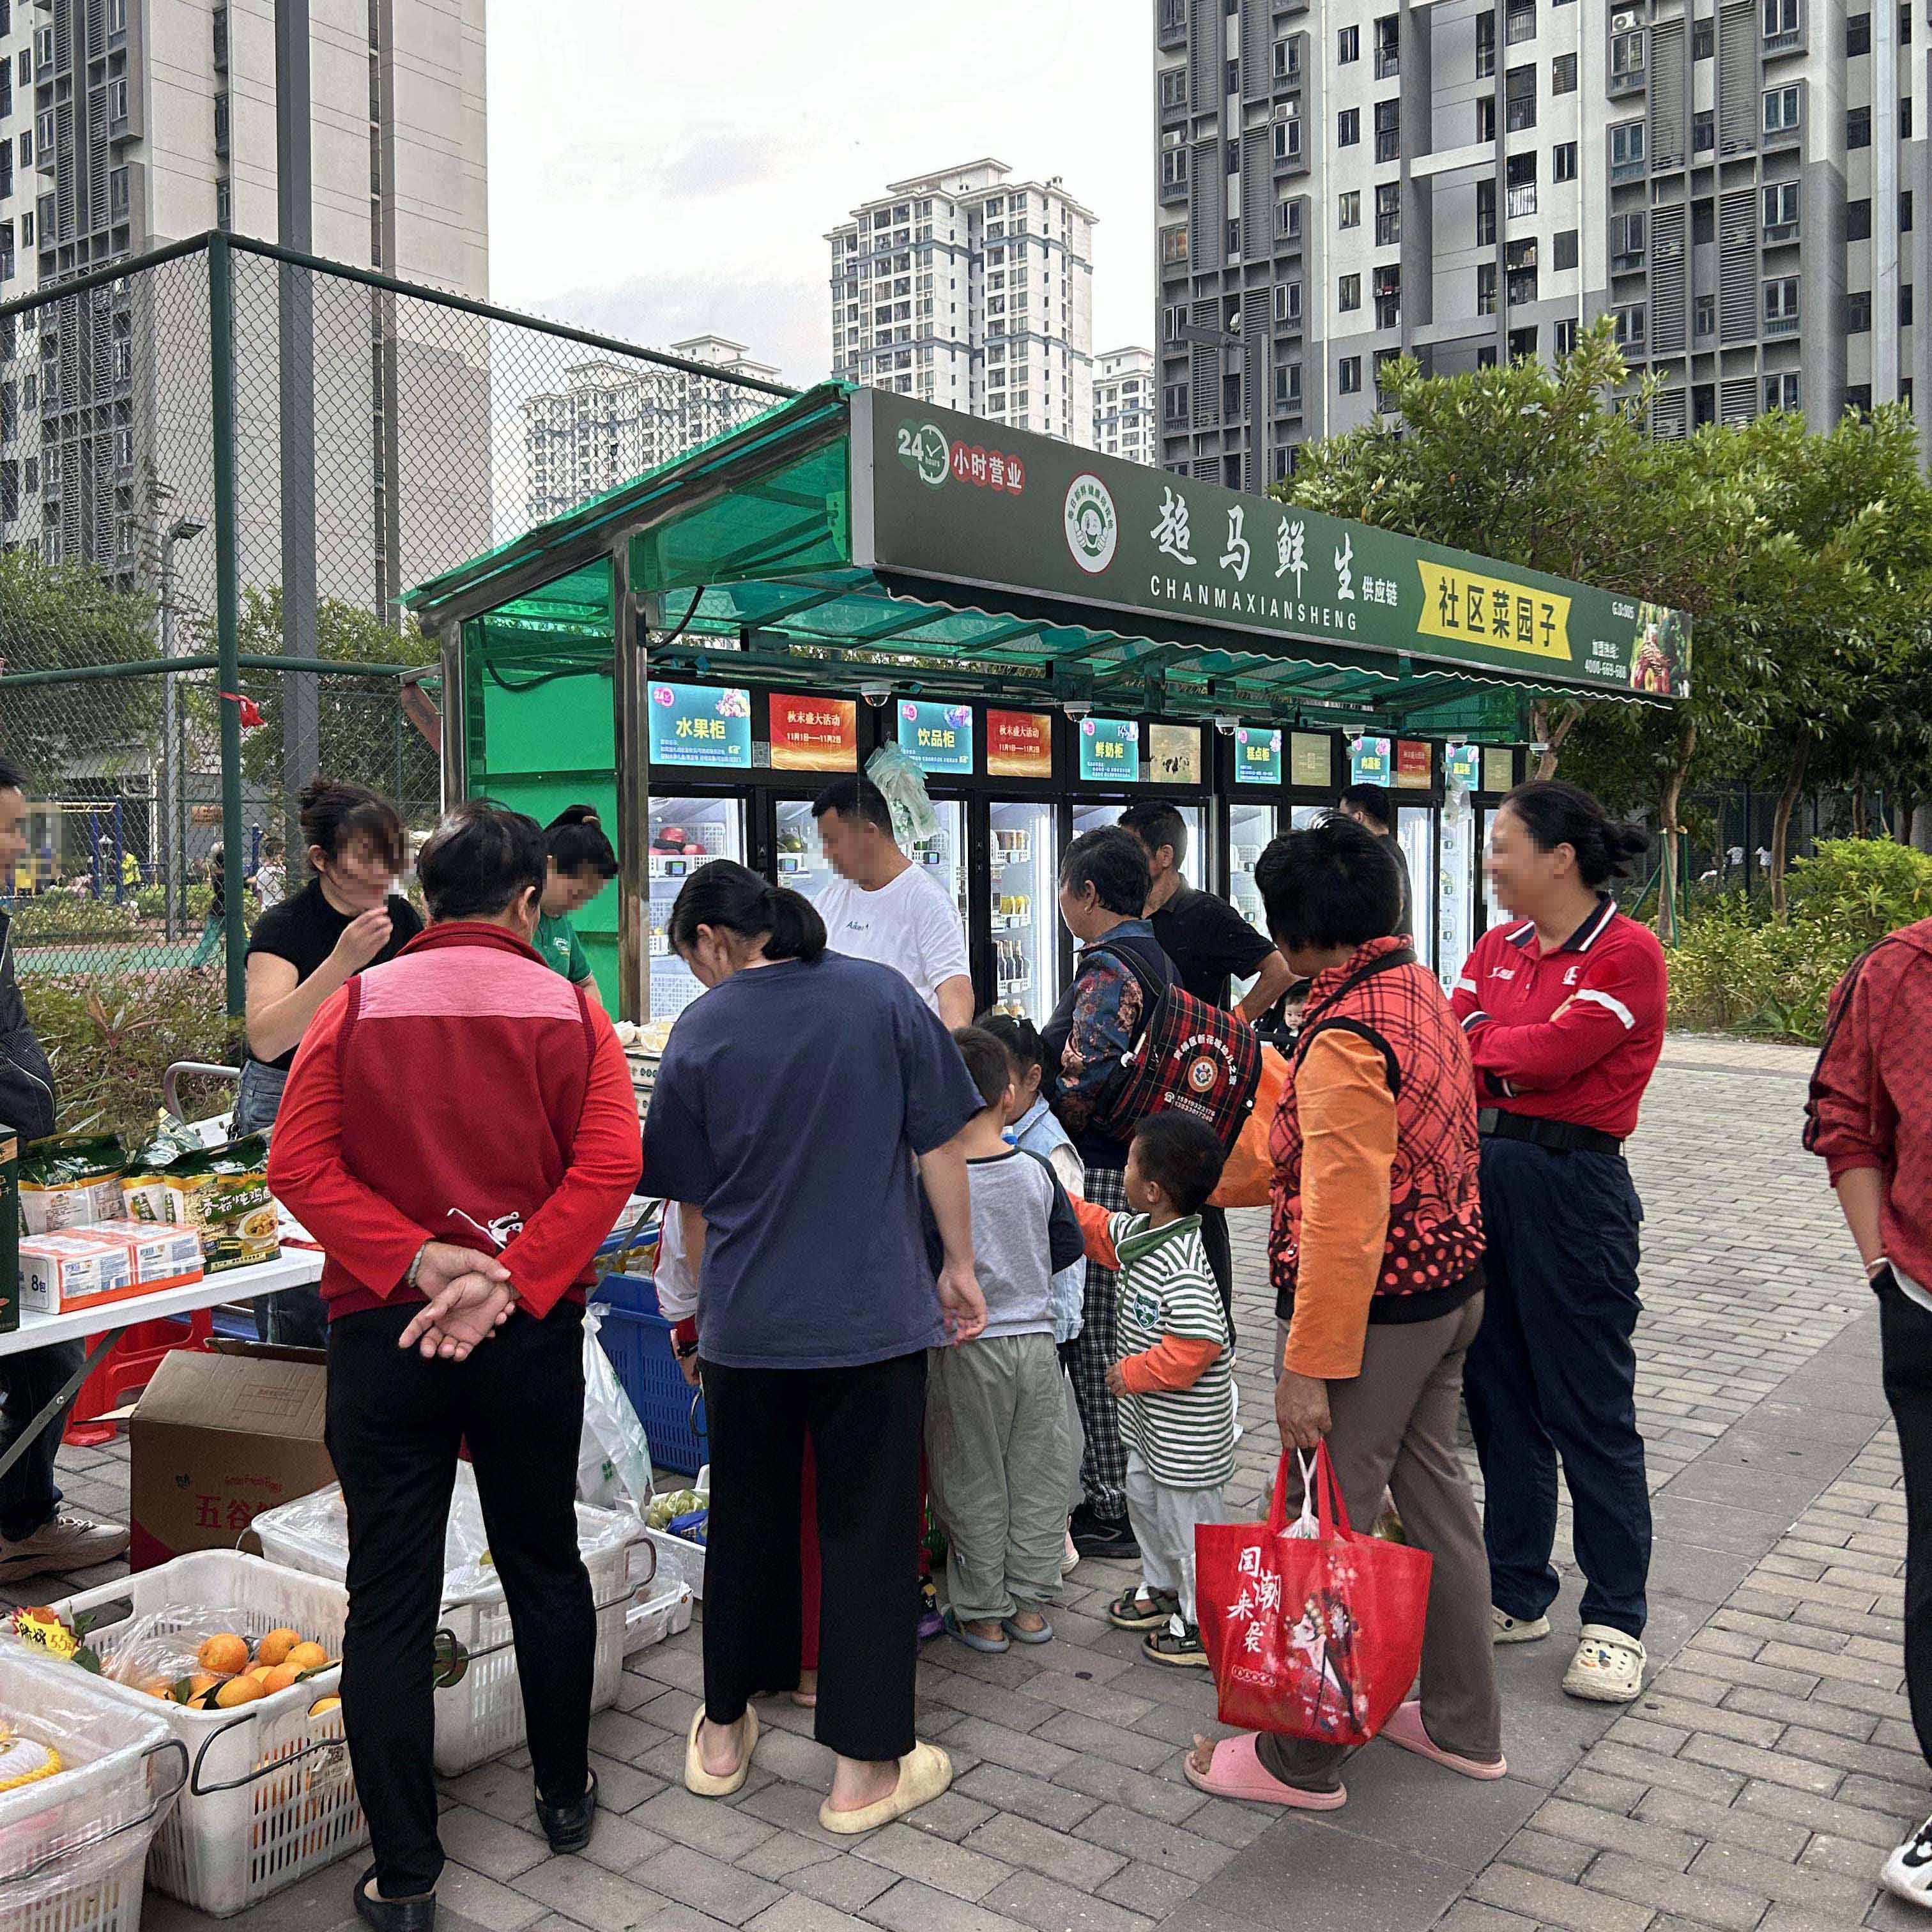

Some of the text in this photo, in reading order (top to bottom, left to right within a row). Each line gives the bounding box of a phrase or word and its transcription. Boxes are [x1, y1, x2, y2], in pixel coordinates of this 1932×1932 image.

[898, 428, 1022, 489] 24 小时营业
[1150, 575, 1356, 631] CHANMAXIANSHENG
[1361, 576, 1399, 607] 供应链
[1438, 576, 1556, 647] 社区菜园子
[675, 716, 726, 739] 水果柜
[786, 710, 841, 726] 秋末盛大活动
[917, 727, 956, 748] 饮品柜
[1094, 740, 1124, 759] 鲜奶柜
[31, 1273, 47, 1293] 8包
[1226, 1545, 1282, 1653] 国潮来袭
